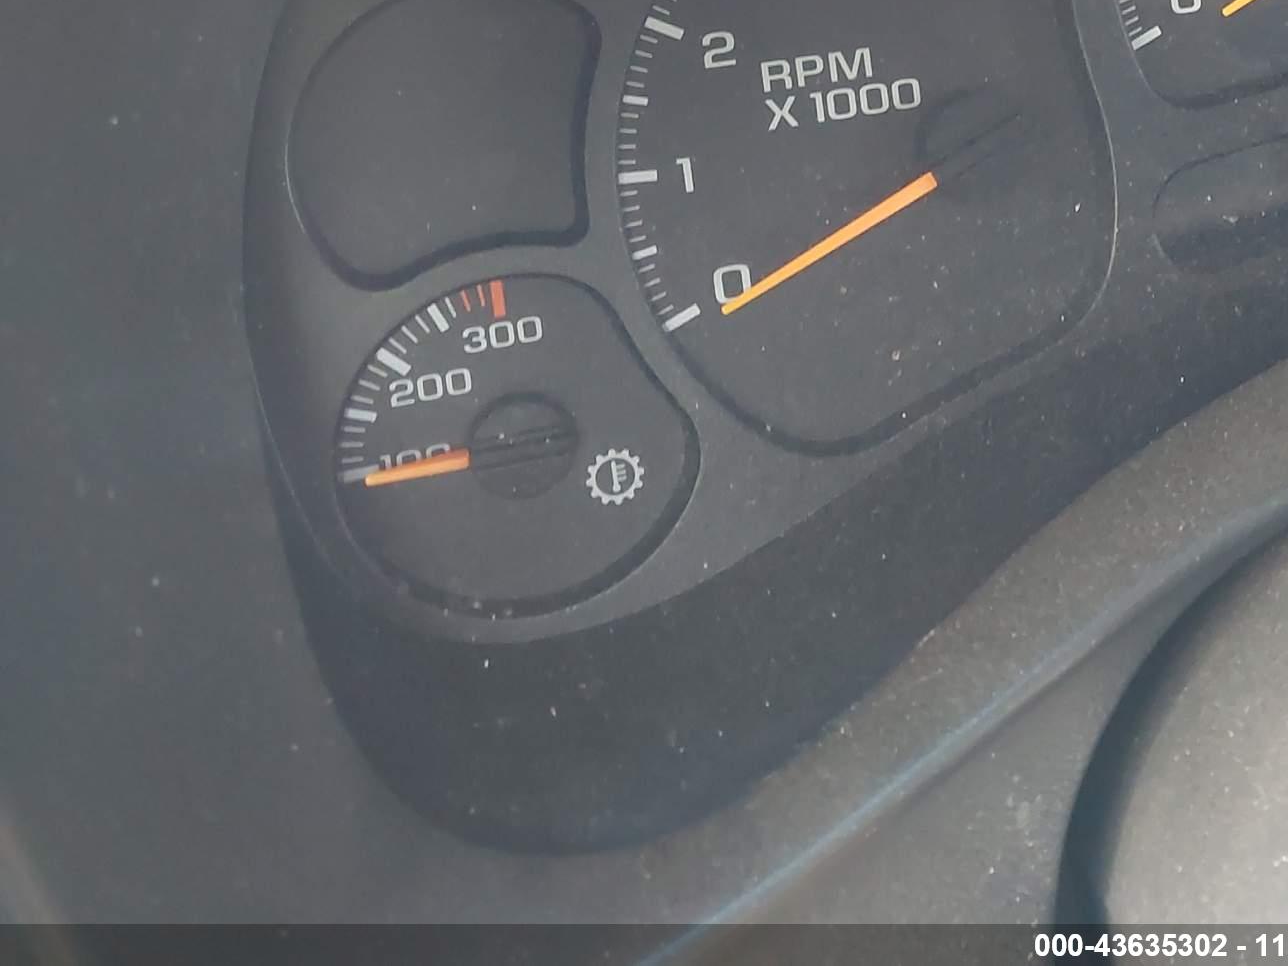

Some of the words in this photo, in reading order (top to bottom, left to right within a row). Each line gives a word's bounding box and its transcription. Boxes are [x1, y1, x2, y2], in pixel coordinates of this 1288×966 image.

[702, 31, 737, 69] 2
[760, 48, 875, 94] RPM
[765, 95, 799, 131] X
[809, 77, 921, 123] 1000
[676, 157, 694, 193] 1
[713, 264, 752, 304] 0
[462, 316, 543, 353] 300
[389, 368, 472, 408] 200
